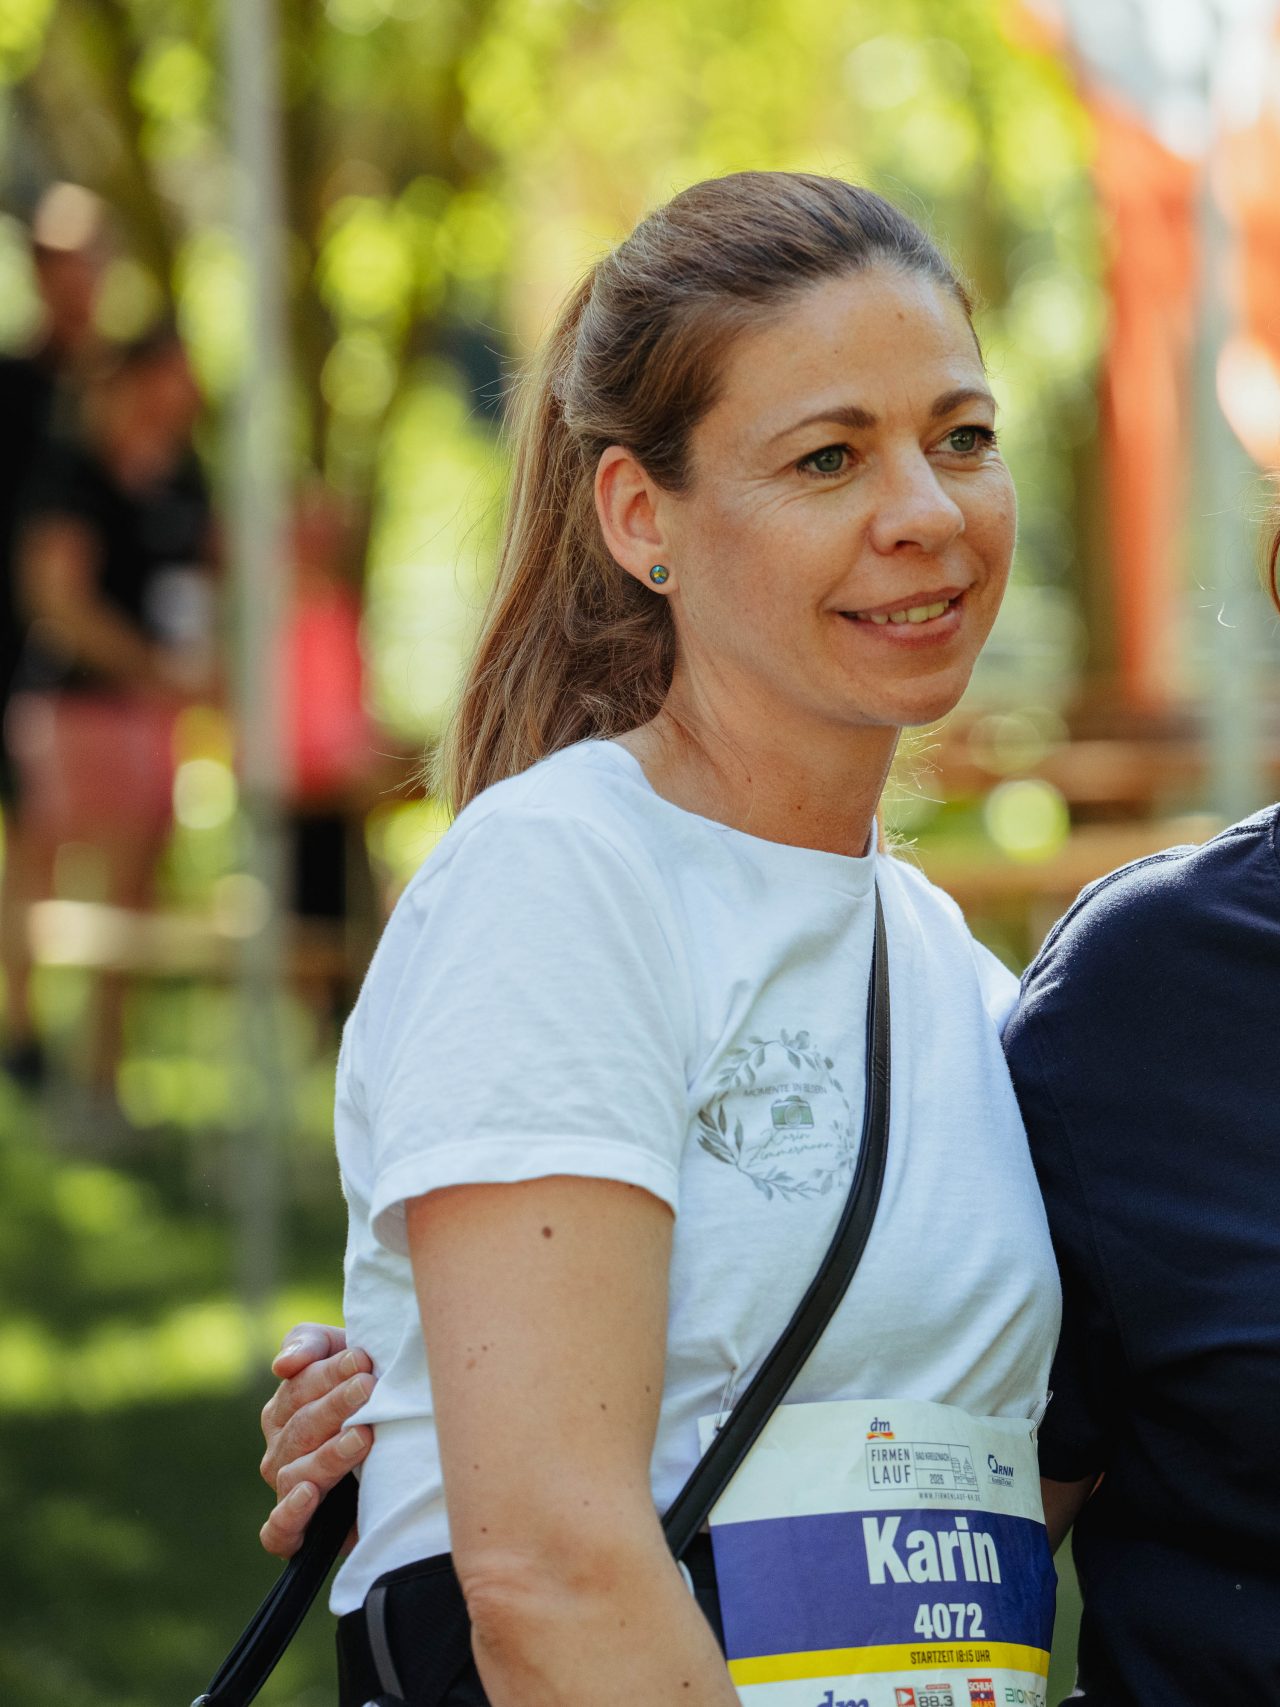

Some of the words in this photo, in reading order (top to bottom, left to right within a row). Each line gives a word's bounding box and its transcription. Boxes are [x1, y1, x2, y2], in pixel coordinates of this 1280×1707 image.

[870, 1417, 890, 1432] dm
[871, 1448, 911, 1462] FIRMEN
[872, 1464, 911, 1484] LAUF
[862, 1516, 1001, 1585] Karin
[913, 1603, 986, 1639] 4072
[910, 1650, 954, 1665] STARTZEIT
[956, 1649, 974, 1663] 18:15
[975, 1649, 991, 1663] UHR
[968, 1681, 993, 1692] SCHUH
[918, 1695, 954, 1707] 88.3
